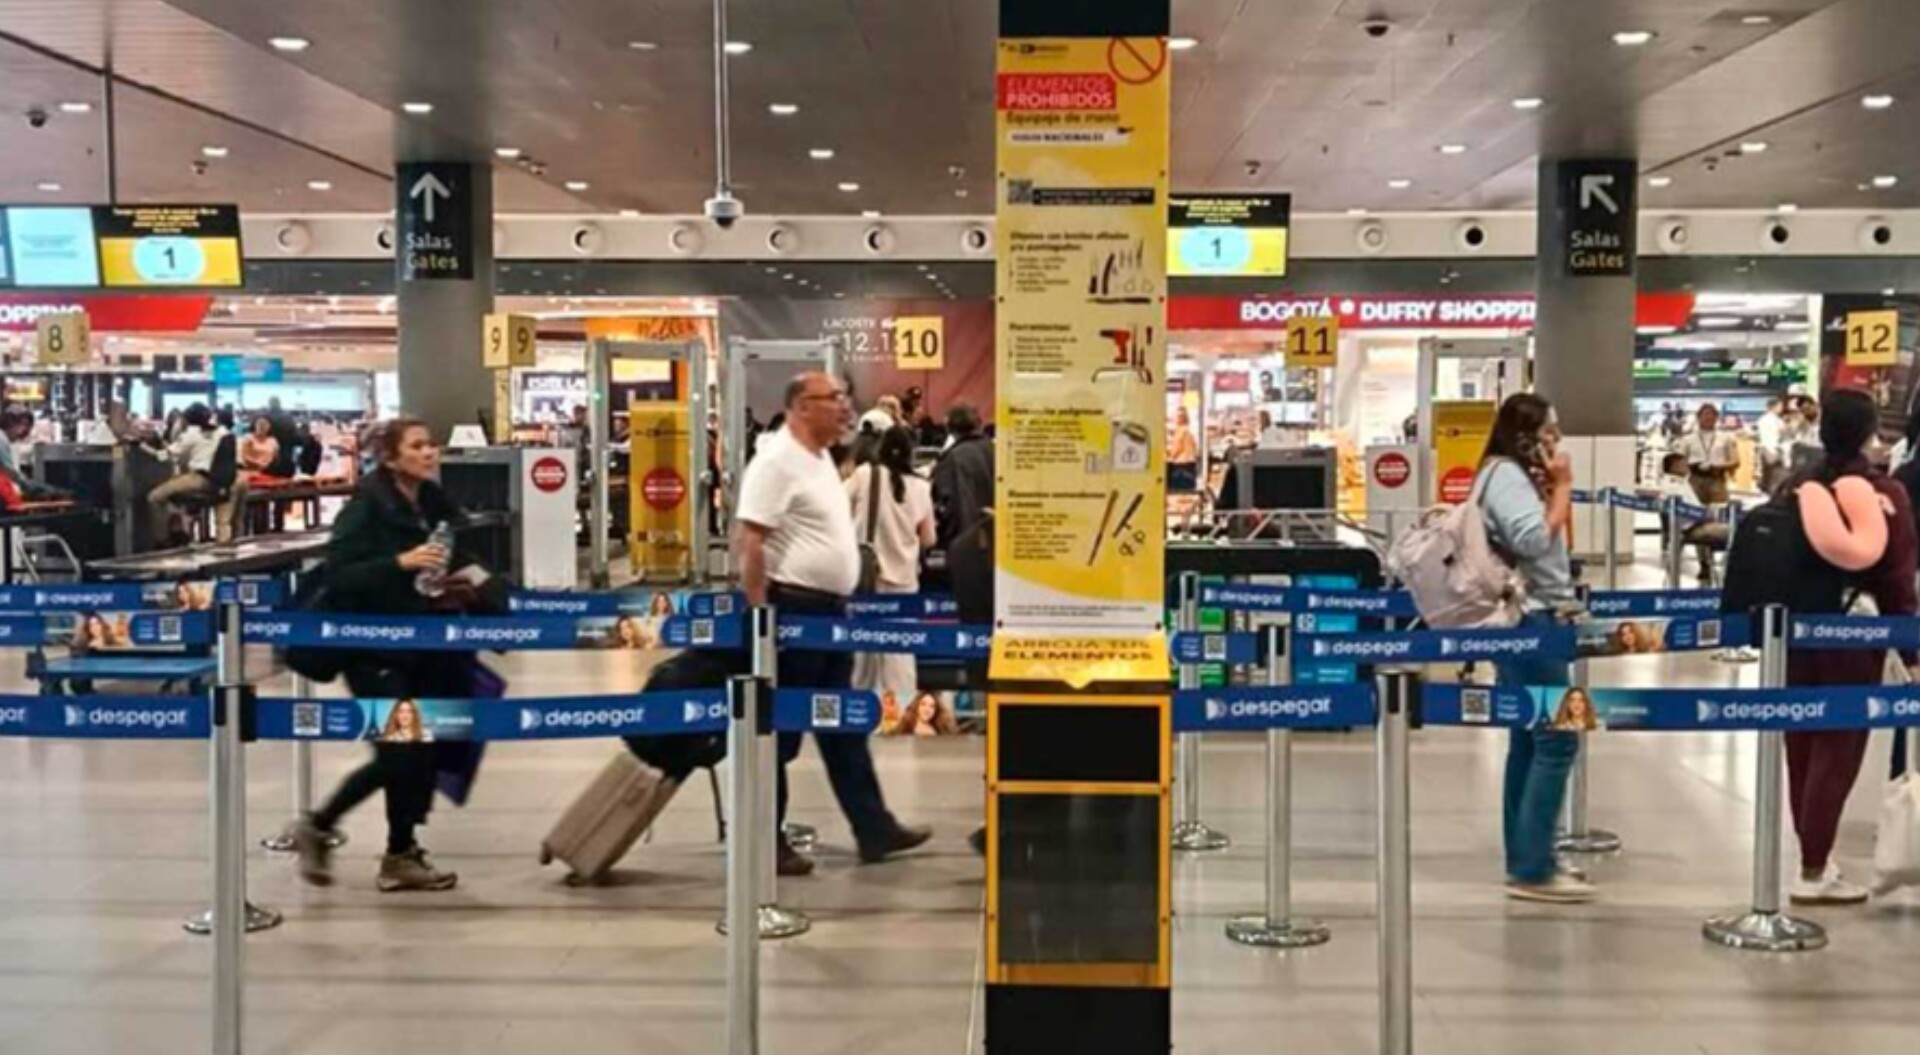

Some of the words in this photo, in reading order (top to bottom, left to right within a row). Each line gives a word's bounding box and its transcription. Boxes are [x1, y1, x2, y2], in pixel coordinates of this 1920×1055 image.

[1008, 77, 1109, 92] ELEMENTOS
[1007, 92, 1113, 109] PROHIBIDOS
[1065, 113, 1080, 123] de
[406, 231, 452, 252] Salas
[1210, 237, 1221, 258] 1
[1571, 231, 1620, 248] Salas
[163, 247, 175, 270] 1
[406, 252, 459, 270] Gates
[1571, 250, 1625, 268] Gates
[1241, 299, 1332, 320] BOGOTÁ
[1361, 301, 1434, 320] DUFRY
[823, 317, 875, 329] LACOSTE
[48, 324, 63, 353] 8
[491, 326, 501, 353] 9
[517, 326, 530, 354] 9
[901, 329, 938, 357] 10
[1290, 327, 1335, 356] 11
[1851, 323, 1890, 354] 12
[50, 590, 114, 606] despegar
[525, 599, 589, 613] despegar
[1219, 590, 1283, 606] despegar
[1324, 596, 1389, 610] despegar
[341, 624, 416, 642] despegar
[465, 626, 541, 643] despegar
[851, 628, 927, 646] despegar
[1814, 624, 1890, 642] despegar
[1006, 639, 1100, 649] ARROJA
[1107, 640, 1150, 649] TUS
[1332, 641, 1411, 657] despegar
[1461, 638, 1540, 654] despegar
[1004, 652, 1153, 660] ELEMENTOS
[545, 705, 646, 728] despegar
[1231, 697, 1331, 719] despegar
[1723, 701, 1828, 722] despegar
[89, 707, 188, 729] despegar
